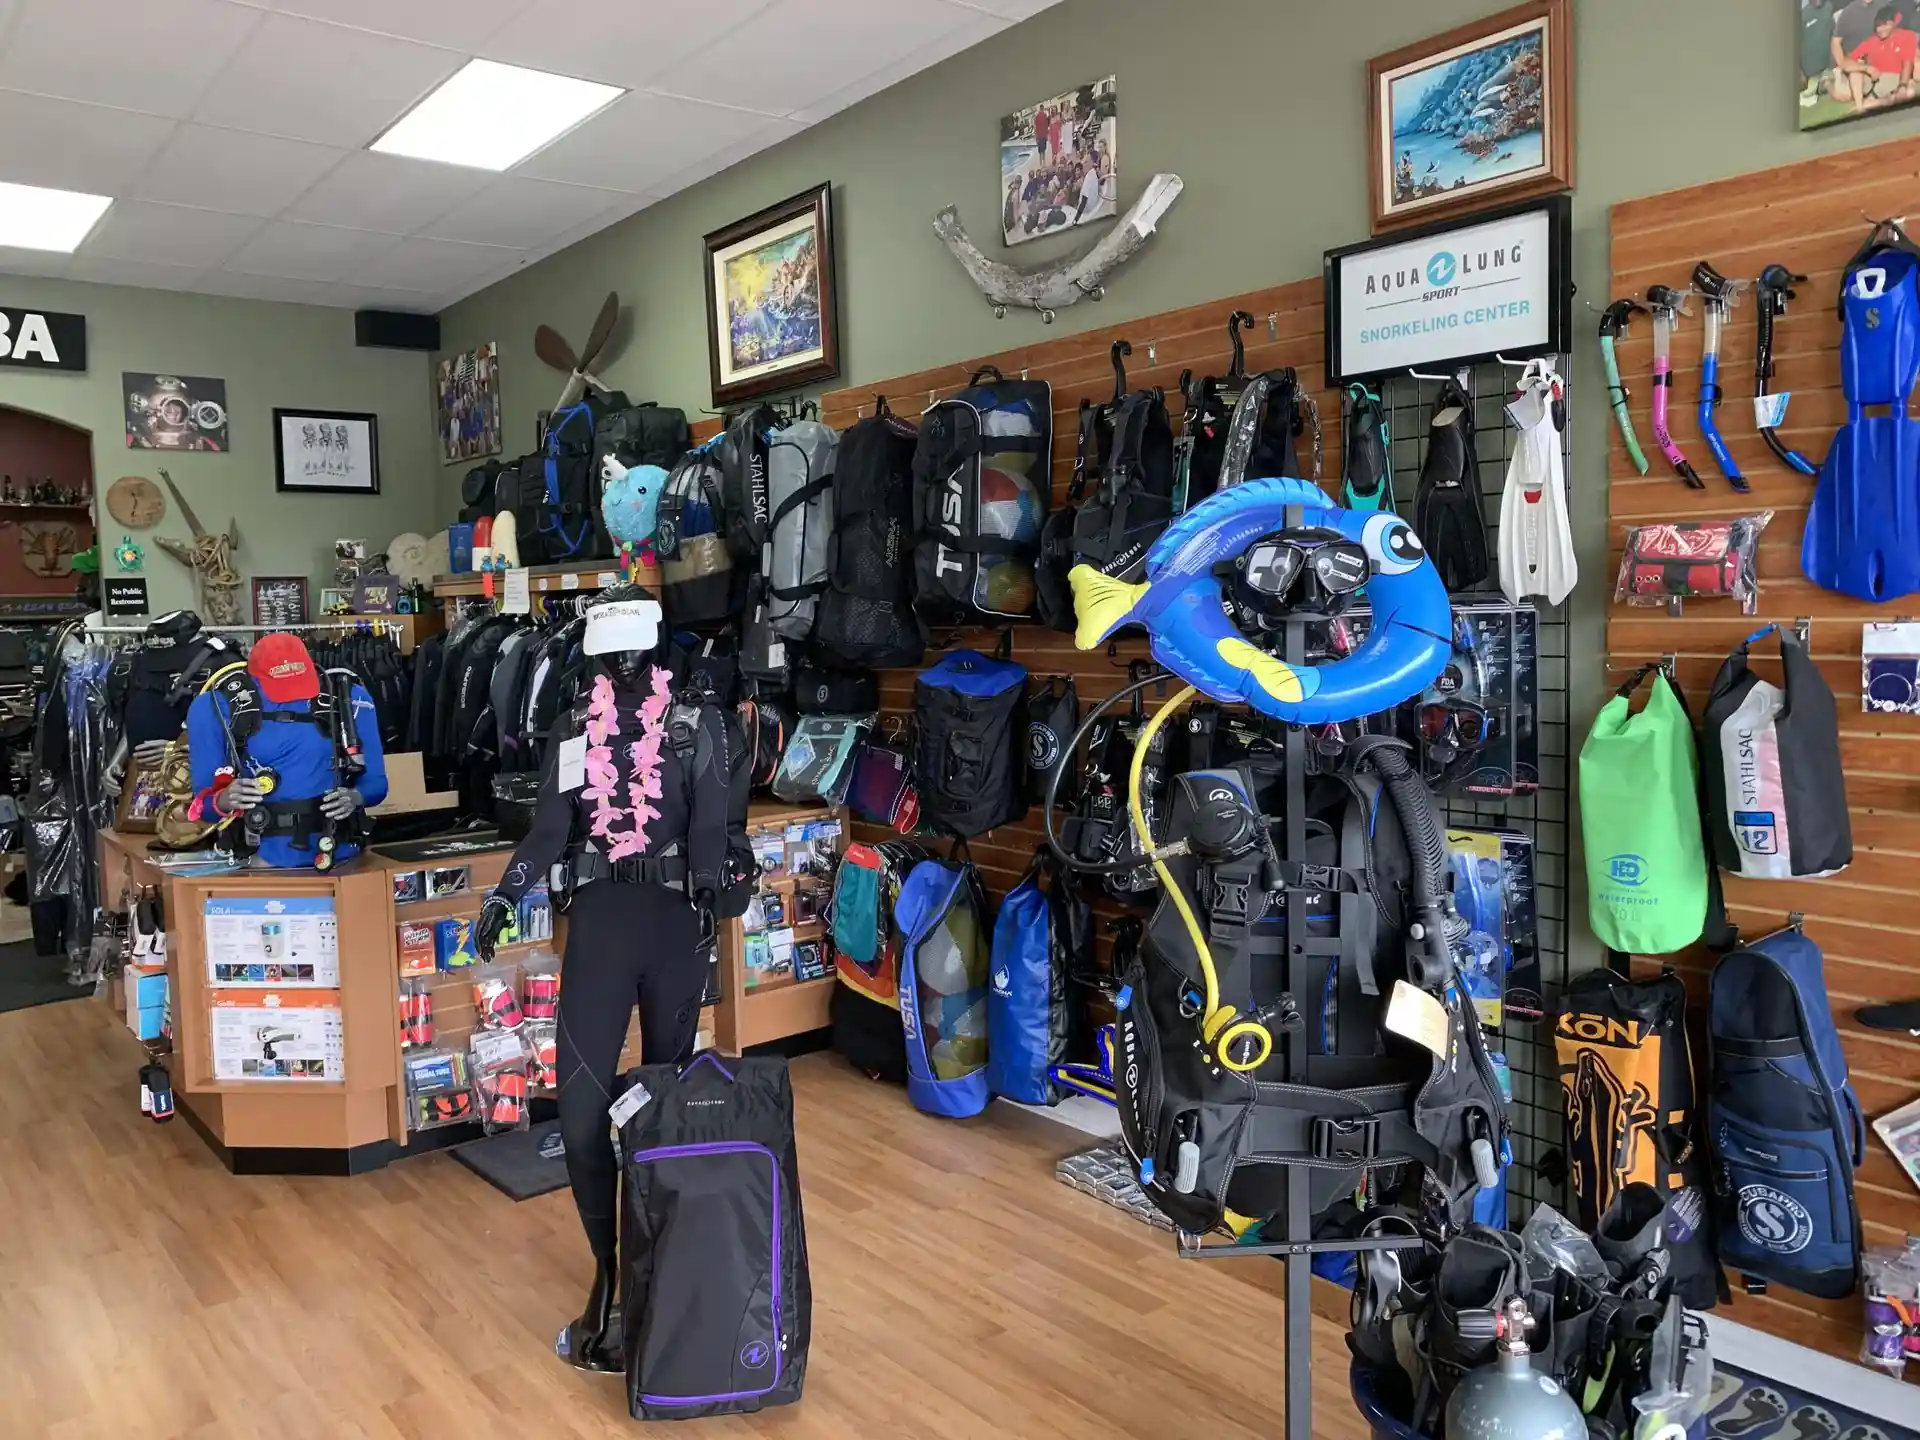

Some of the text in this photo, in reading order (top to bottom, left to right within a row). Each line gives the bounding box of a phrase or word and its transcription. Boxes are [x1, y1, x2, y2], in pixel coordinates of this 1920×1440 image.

[1365, 244, 1522, 295] AQUA LUNG
[1421, 286, 1461, 302] SPORT
[1360, 300, 1531, 344] SNORKELING CENTER
[749, 453, 768, 525] STAHLSAC
[122, 587, 143, 595] Public
[1738, 727, 1758, 806] STAHLSAC
[1741, 829, 1769, 850] 12
[901, 986, 916, 1039] TUSA
[1740, 1187, 1805, 1219] CUBAPRO
